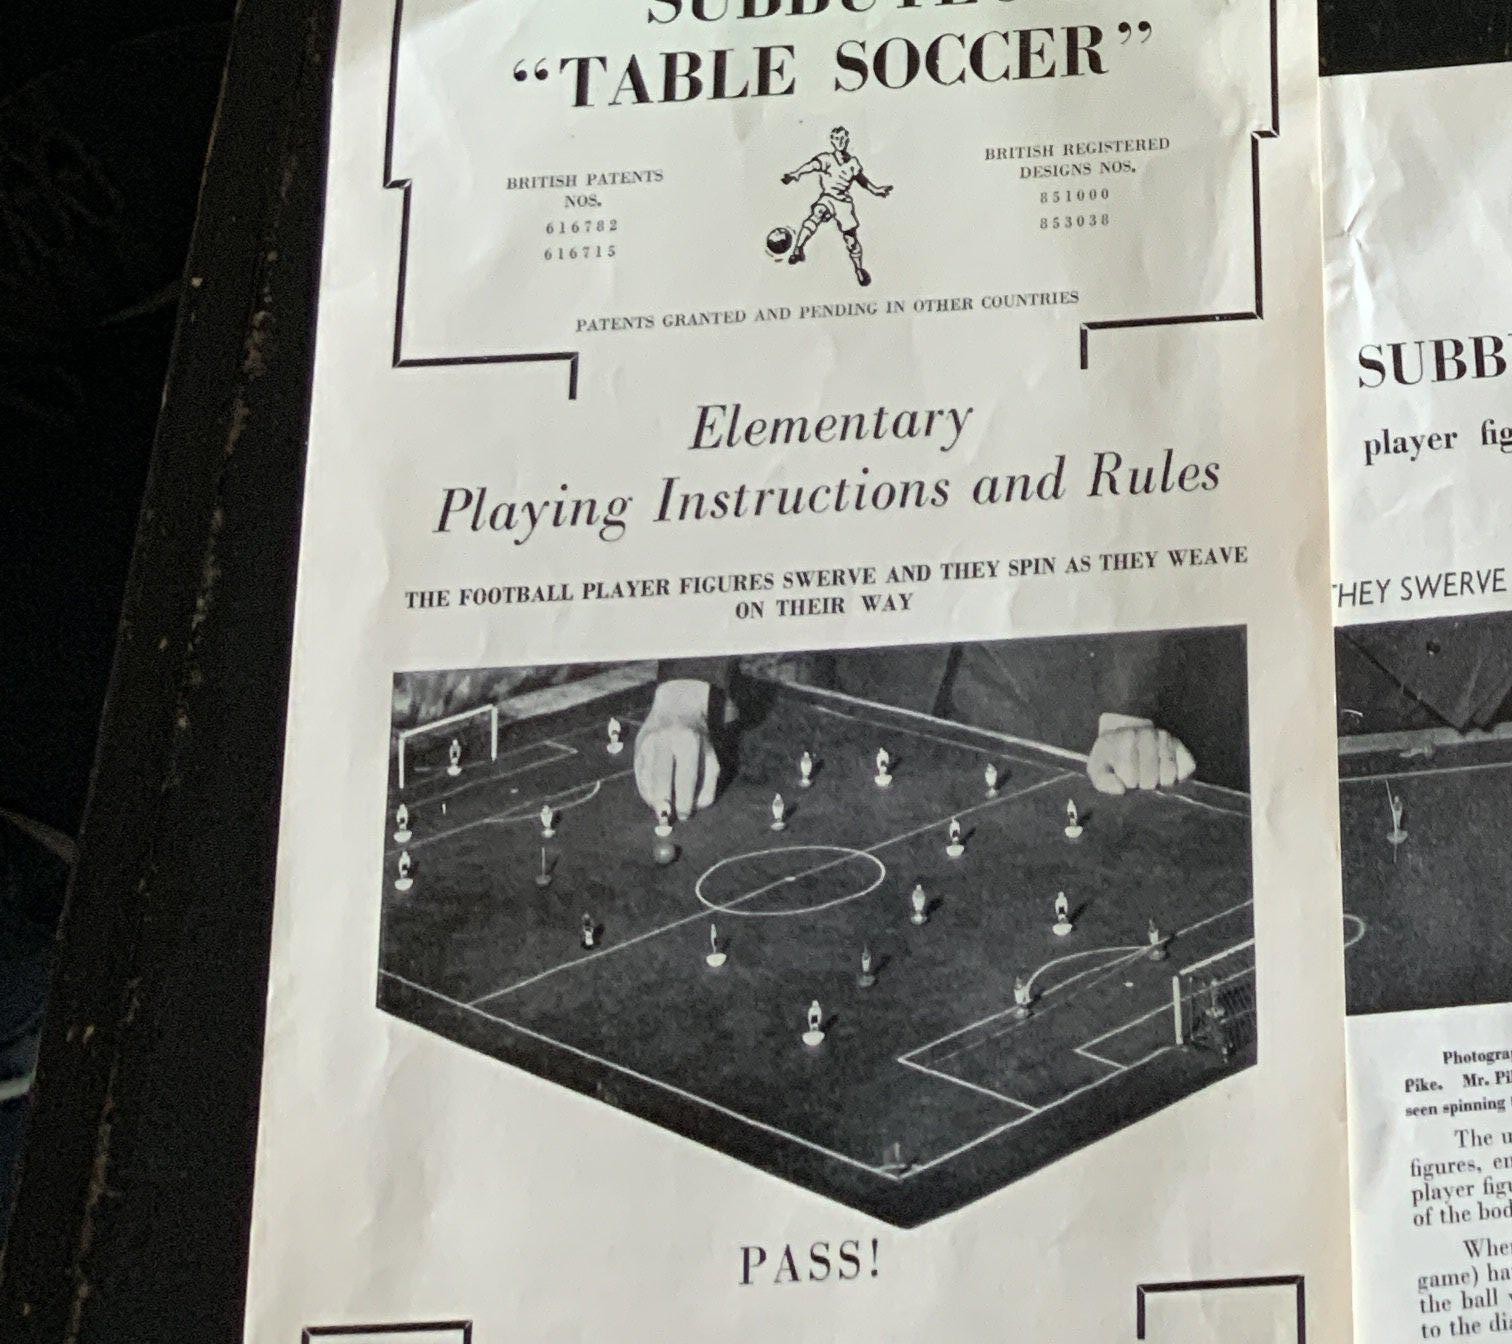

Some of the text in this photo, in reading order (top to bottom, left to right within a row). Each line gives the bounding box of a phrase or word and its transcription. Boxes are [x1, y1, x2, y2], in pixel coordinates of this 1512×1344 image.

[513, 21, 1152, 107] “TABLE SOCCER”
[985, 137, 1170, 161] BRITISH REGISTERED
[506, 170, 664, 190] BRITISH PATENTS
[1020, 160, 1136, 179] DESIGNS NOS.
[565, 194, 602, 208] NOS.
[1040, 188, 1109, 203] 851000
[546, 219, 617, 235] 616782
[1040, 214, 1109, 230] 853038
[544, 245, 616, 261] 616715
[576, 290, 1079, 332] PATENTS GRANTED AND PENDING IN OTHER COUNTRIES
[688, 403, 973, 452] Elementary
[1364, 429, 1457, 466] player
[432, 448, 1219, 545] Playing Instructions and Rules
[405, 546, 1247, 609] THE FOOTBALL PLAYER FIGURES SWERVE AND THEY SPIN AS THEY WEAVE
[736, 593, 913, 619] ON THEIR WAY
[1406, 1106, 1438, 1116] seen
[1443, 1097, 1505, 1117] spinning
[739, 1238, 880, 1286] PASS!
[1421, 1324, 1441, 1339] to
[1449, 1316, 1481, 1336] the
